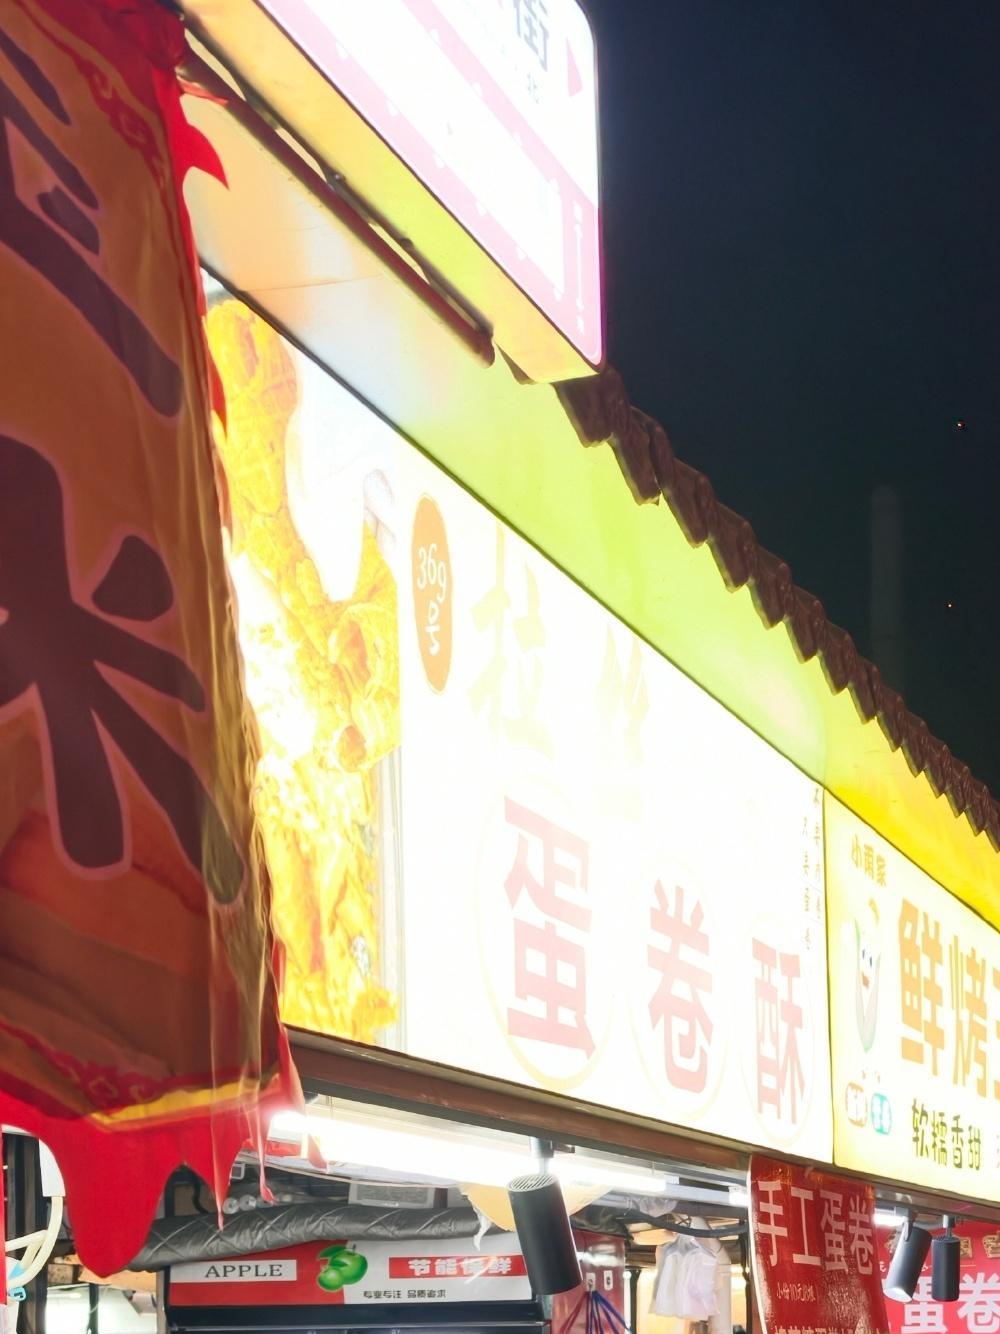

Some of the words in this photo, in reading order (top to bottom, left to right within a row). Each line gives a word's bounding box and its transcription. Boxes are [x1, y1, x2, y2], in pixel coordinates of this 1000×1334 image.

[503, 795, 805, 1126] 蛋卷酥
[911, 1097, 982, 1170] 软糯香甜
[757, 1178, 875, 1276] 手工蛋卷
[204, 1263, 283, 1279] APPLE
[408, 1256, 512, 1277] 节能保鲜
